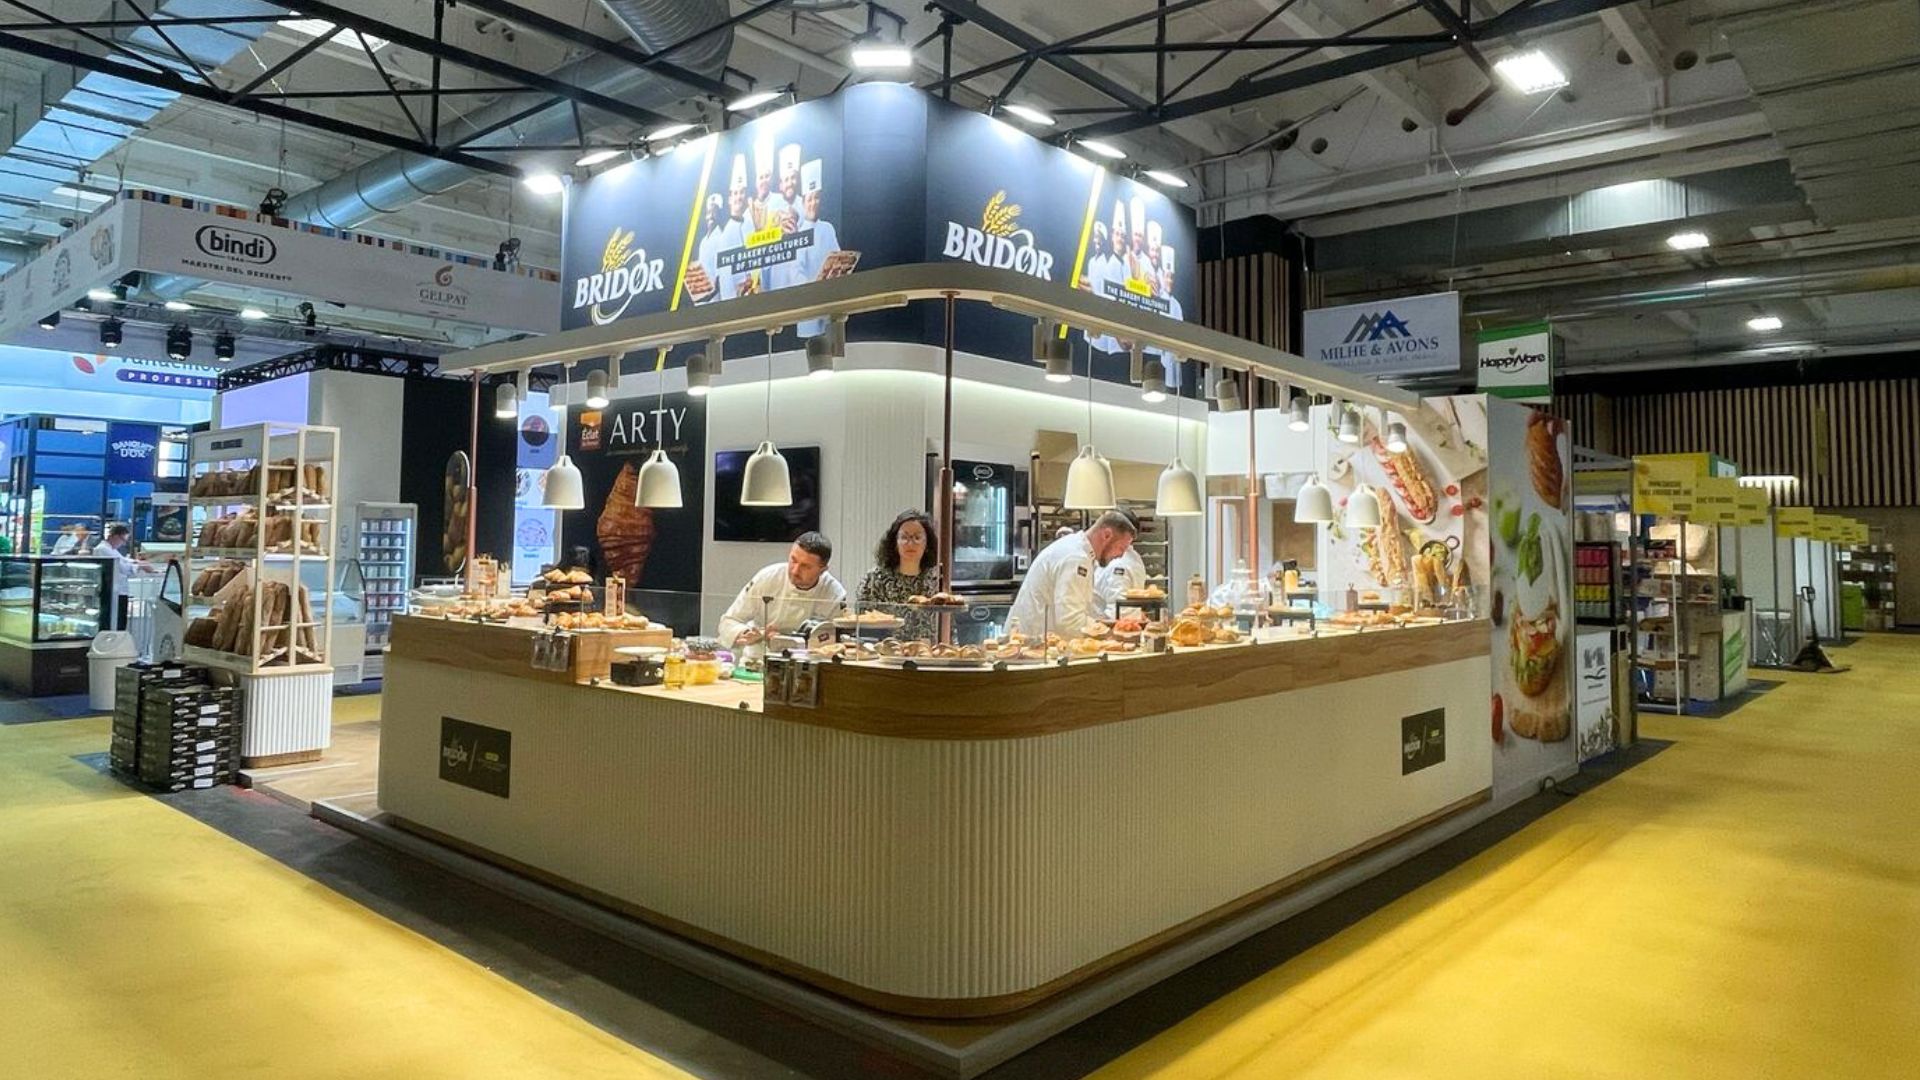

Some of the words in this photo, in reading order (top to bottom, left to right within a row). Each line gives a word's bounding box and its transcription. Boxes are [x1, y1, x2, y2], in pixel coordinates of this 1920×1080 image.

[209, 229, 265, 259] bindi
[721, 253, 736, 265] THE
[737, 246, 768, 262] BAKERY
[768, 236, 809, 254] CULTURES
[942, 221, 1055, 281] BRIDOR
[748, 257, 762, 268] THE
[764, 250, 793, 264] WORLD
[419, 288, 469, 306] GELPAT
[573, 256, 665, 309] BRIDOR
[1320, 344, 1368, 361] MILHE
[1370, 343, 1382, 356] &
[1387, 336, 1440, 354] AVONS
[127, 371, 218, 387] PROFESSI
[609, 406, 688, 445] ARTY
